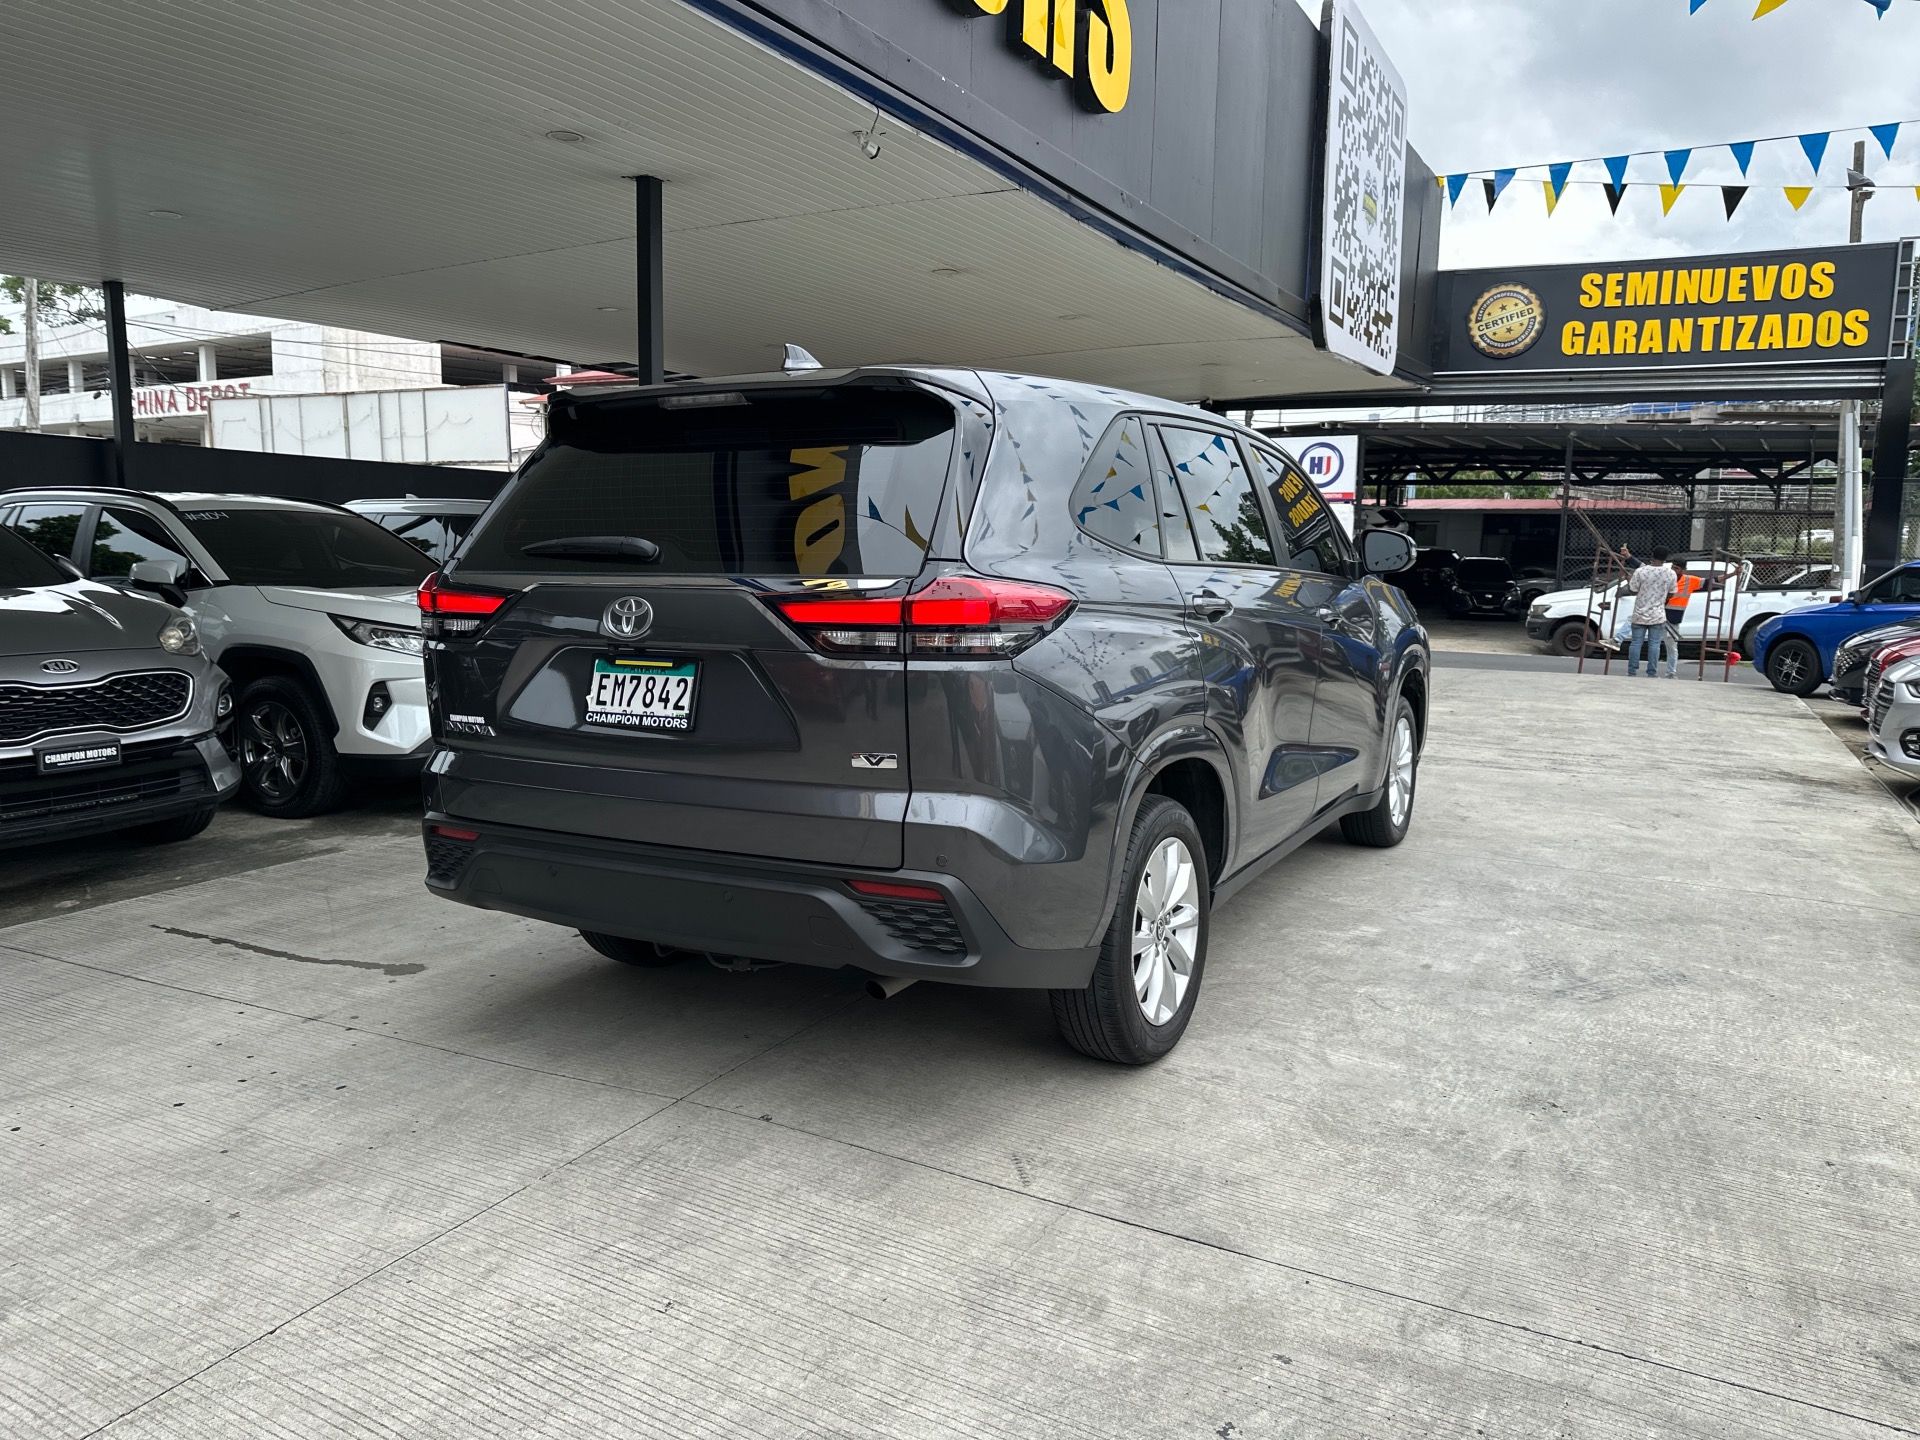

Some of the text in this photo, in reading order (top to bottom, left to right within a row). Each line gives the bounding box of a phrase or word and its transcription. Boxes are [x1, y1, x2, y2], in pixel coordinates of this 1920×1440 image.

[1579, 261, 1836, 308] SEMINUEVOS
[1477, 307, 1535, 332] CERTIFIED
[1561, 309, 1870, 356] GARANTIZADOS
[131, 389, 179, 415] HINA
[1309, 456, 1331, 475] HJ
[46, 661, 76, 671] KIA
[594, 673, 690, 711] EM7842
[585, 712, 640, 726] CHAMPION
[641, 715, 689, 729] MOTORS
[45, 751, 85, 763] CHAMPION
[86, 747, 117, 758] MOTORS
